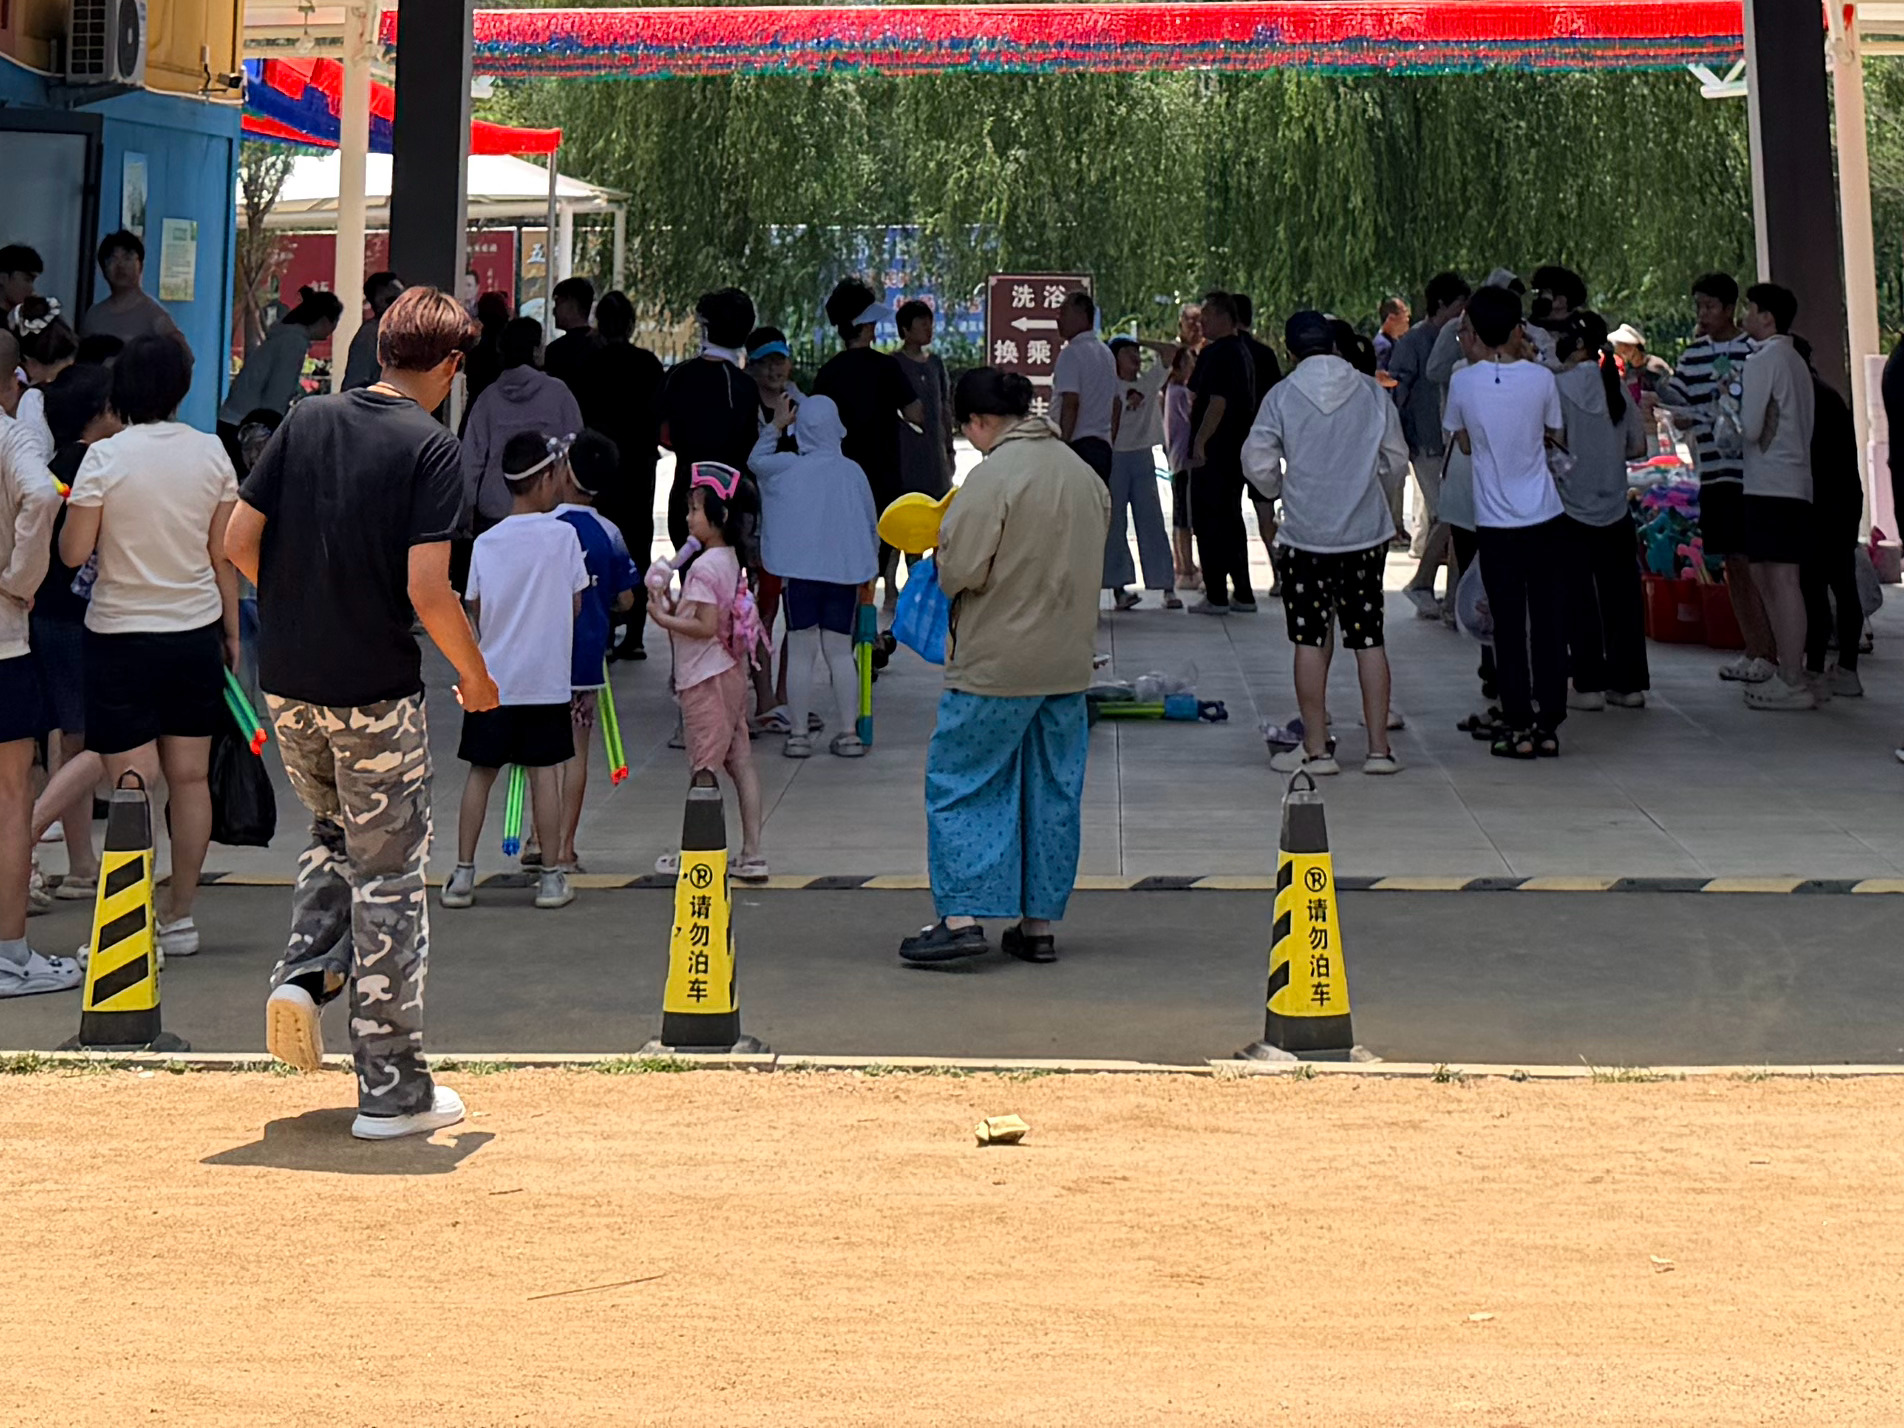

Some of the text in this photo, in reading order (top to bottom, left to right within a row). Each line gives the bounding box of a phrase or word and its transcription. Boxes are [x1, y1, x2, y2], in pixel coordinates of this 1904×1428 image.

[1011, 284, 1066, 309] 洗浴
[994, 339, 1070, 365] 换乘
[687, 894, 712, 1004] 请勿泊车
[1306, 898, 1332, 1008] 请勿泊车
